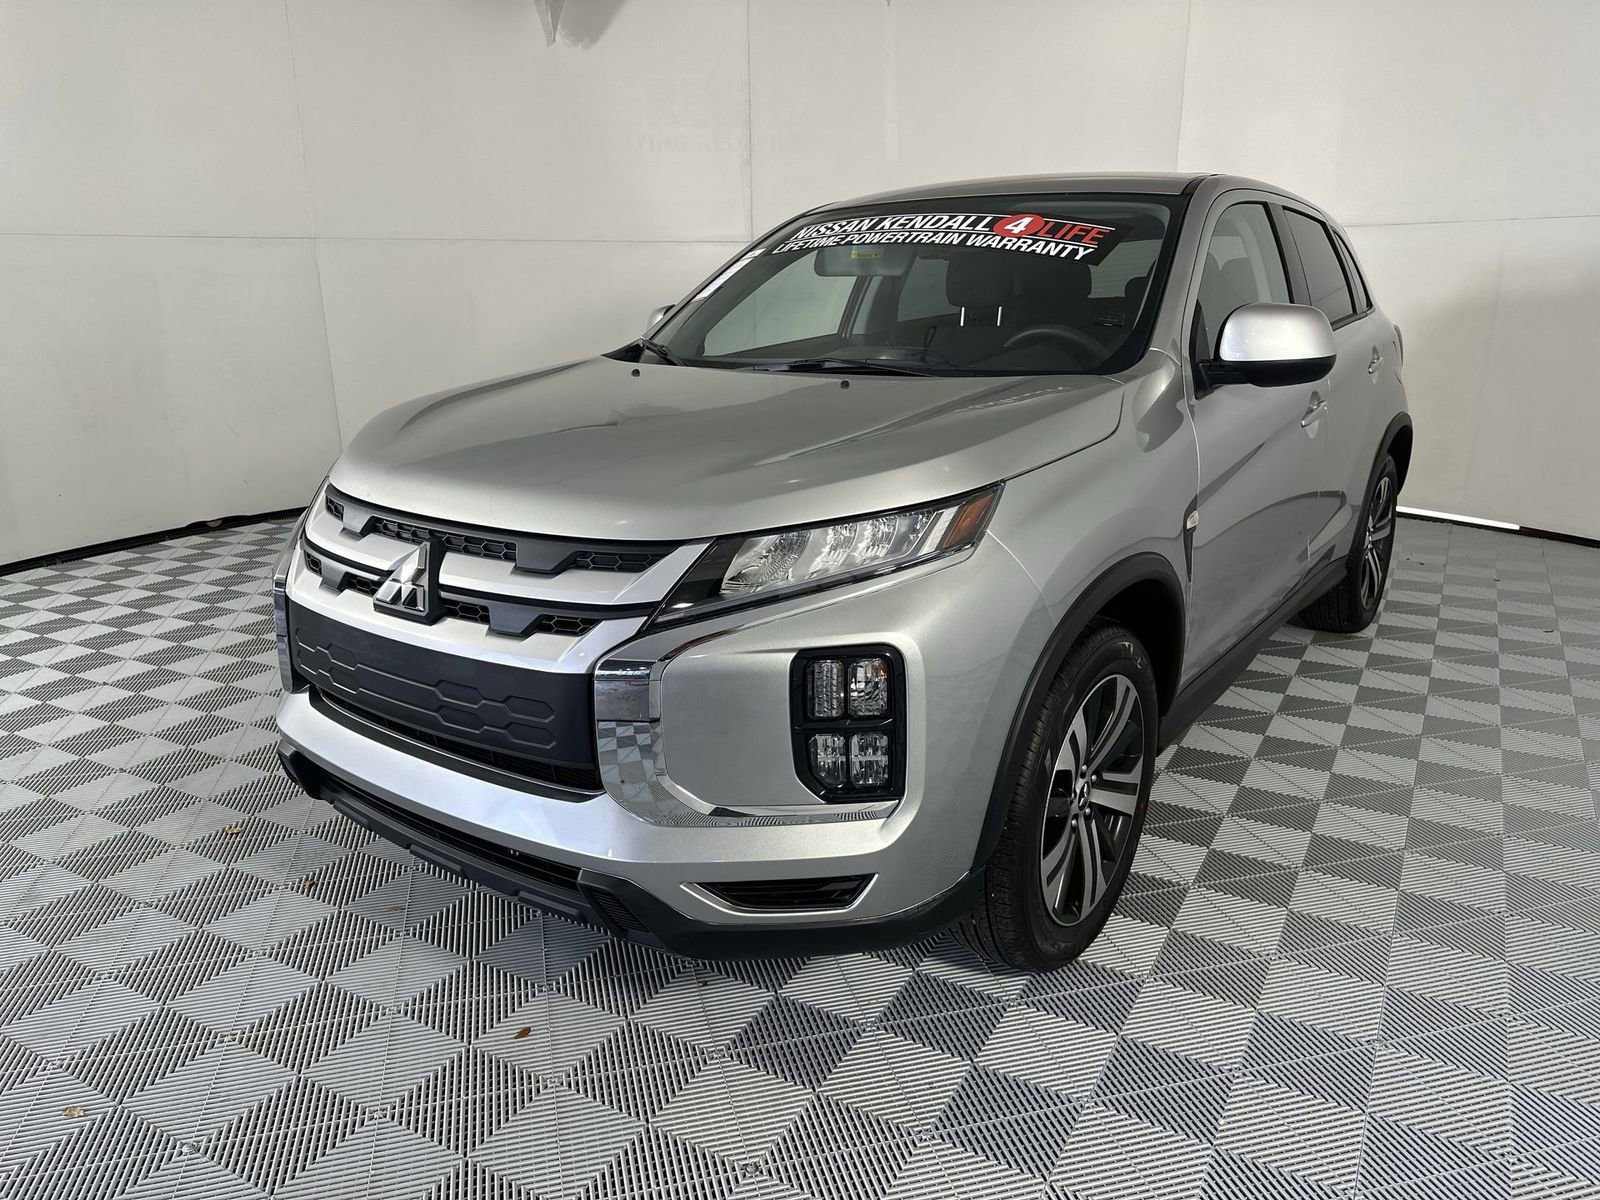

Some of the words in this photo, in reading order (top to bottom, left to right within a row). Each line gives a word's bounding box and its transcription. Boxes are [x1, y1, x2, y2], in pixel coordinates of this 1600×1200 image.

[791, 217, 880, 240] NISSAN
[875, 215, 992, 232] KENDALL
[1003, 217, 1034, 234] 4
[1036, 221, 1110, 245] LIFE
[772, 235, 846, 254] LIFETIME
[841, 232, 964, 246] POWERTRAIN
[965, 234, 1095, 261] WARRANTY
